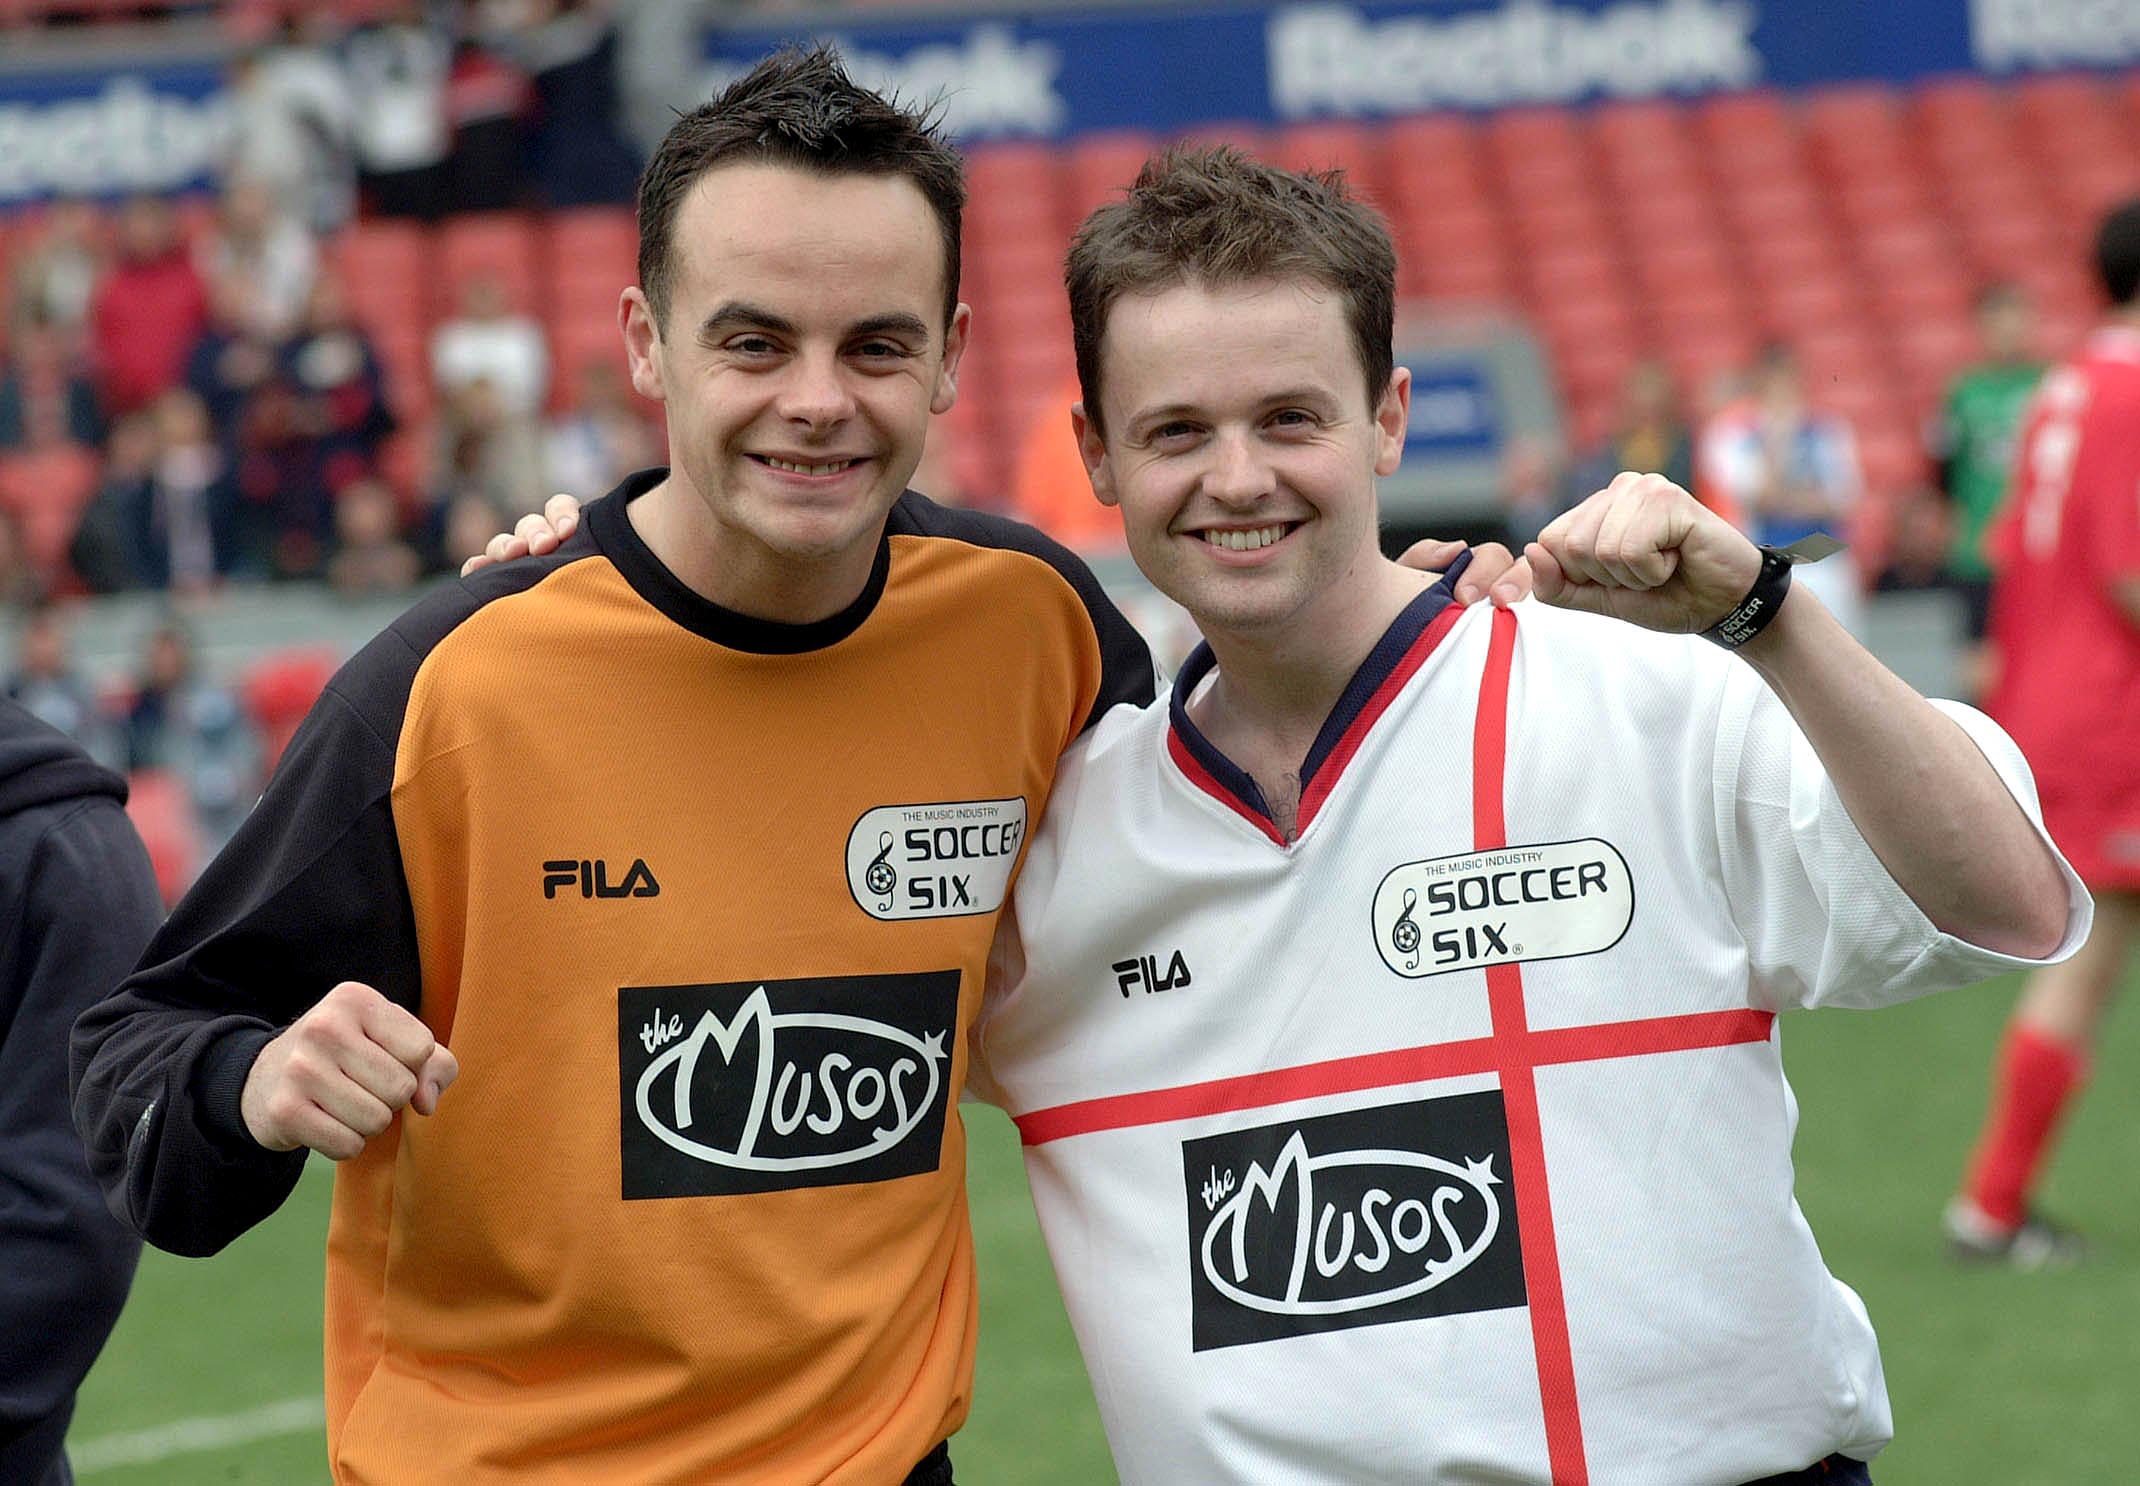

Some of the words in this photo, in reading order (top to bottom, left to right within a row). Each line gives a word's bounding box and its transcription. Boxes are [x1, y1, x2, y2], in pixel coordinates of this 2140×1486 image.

[1723, 597, 1763, 634] SOCCER
[903, 811, 922, 822] THE
[924, 809, 954, 821] MUSIC
[956, 807, 1000, 819] INDUSTRY
[905, 820, 1021, 861] SOCCER
[543, 859, 660, 899] FILA
[1425, 865, 1446, 876] THE
[1448, 858, 1483, 873] MUSIC
[1485, 852, 1544, 868] INDUSTRY
[1428, 861, 1607, 916] SOCCER
[1112, 950, 1191, 998] FILA
[639, 1008, 683, 1054] the
[1201, 1165, 1235, 1212] the
